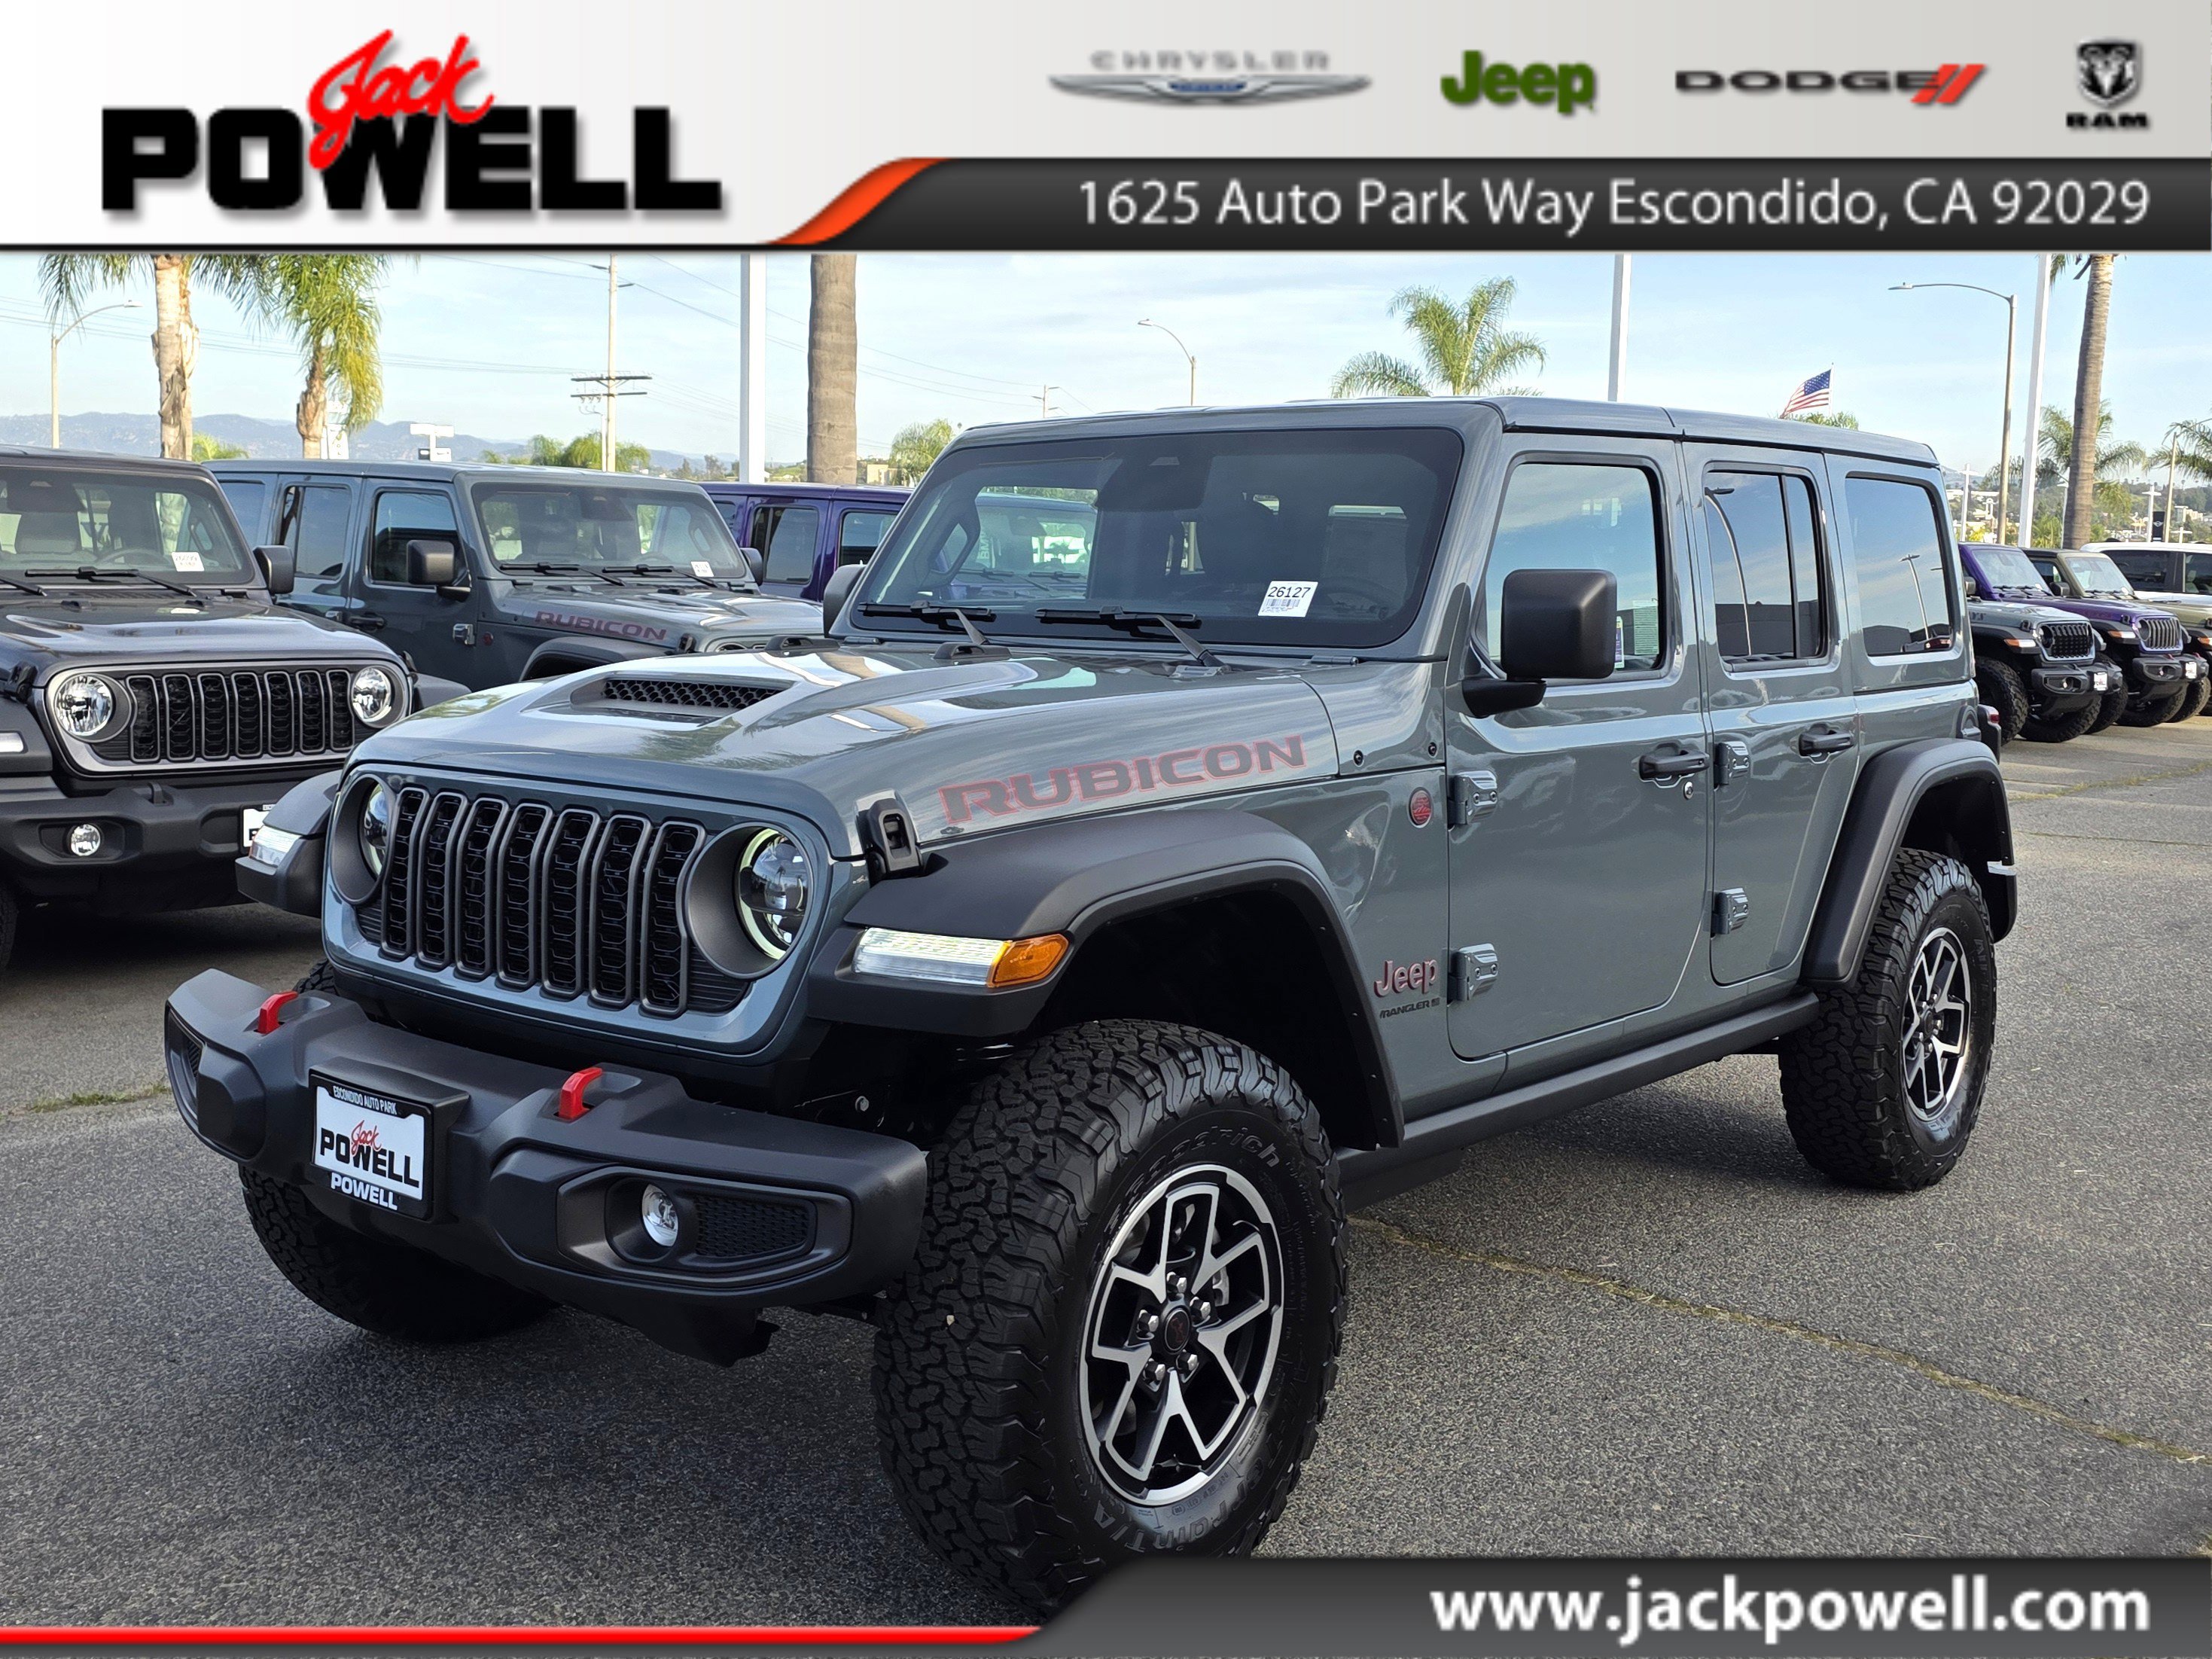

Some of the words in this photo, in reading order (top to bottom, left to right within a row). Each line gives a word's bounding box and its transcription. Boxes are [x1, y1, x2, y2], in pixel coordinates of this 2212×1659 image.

[1267, 586, 1312, 598] 26127
[535, 611, 667, 640] RUBICON
[938, 735, 1307, 825] RUBICON
[1374, 959, 1438, 998] Jeep
[332, 1085, 364, 1106] ESCONDIDO
[364, 1095, 379, 1112] AUTO
[379, 1099, 398, 1115] PARK
[320, 1127, 419, 1188] POWELL
[351, 1120, 382, 1157] Jack
[330, 1172, 398, 1211] POWELL
